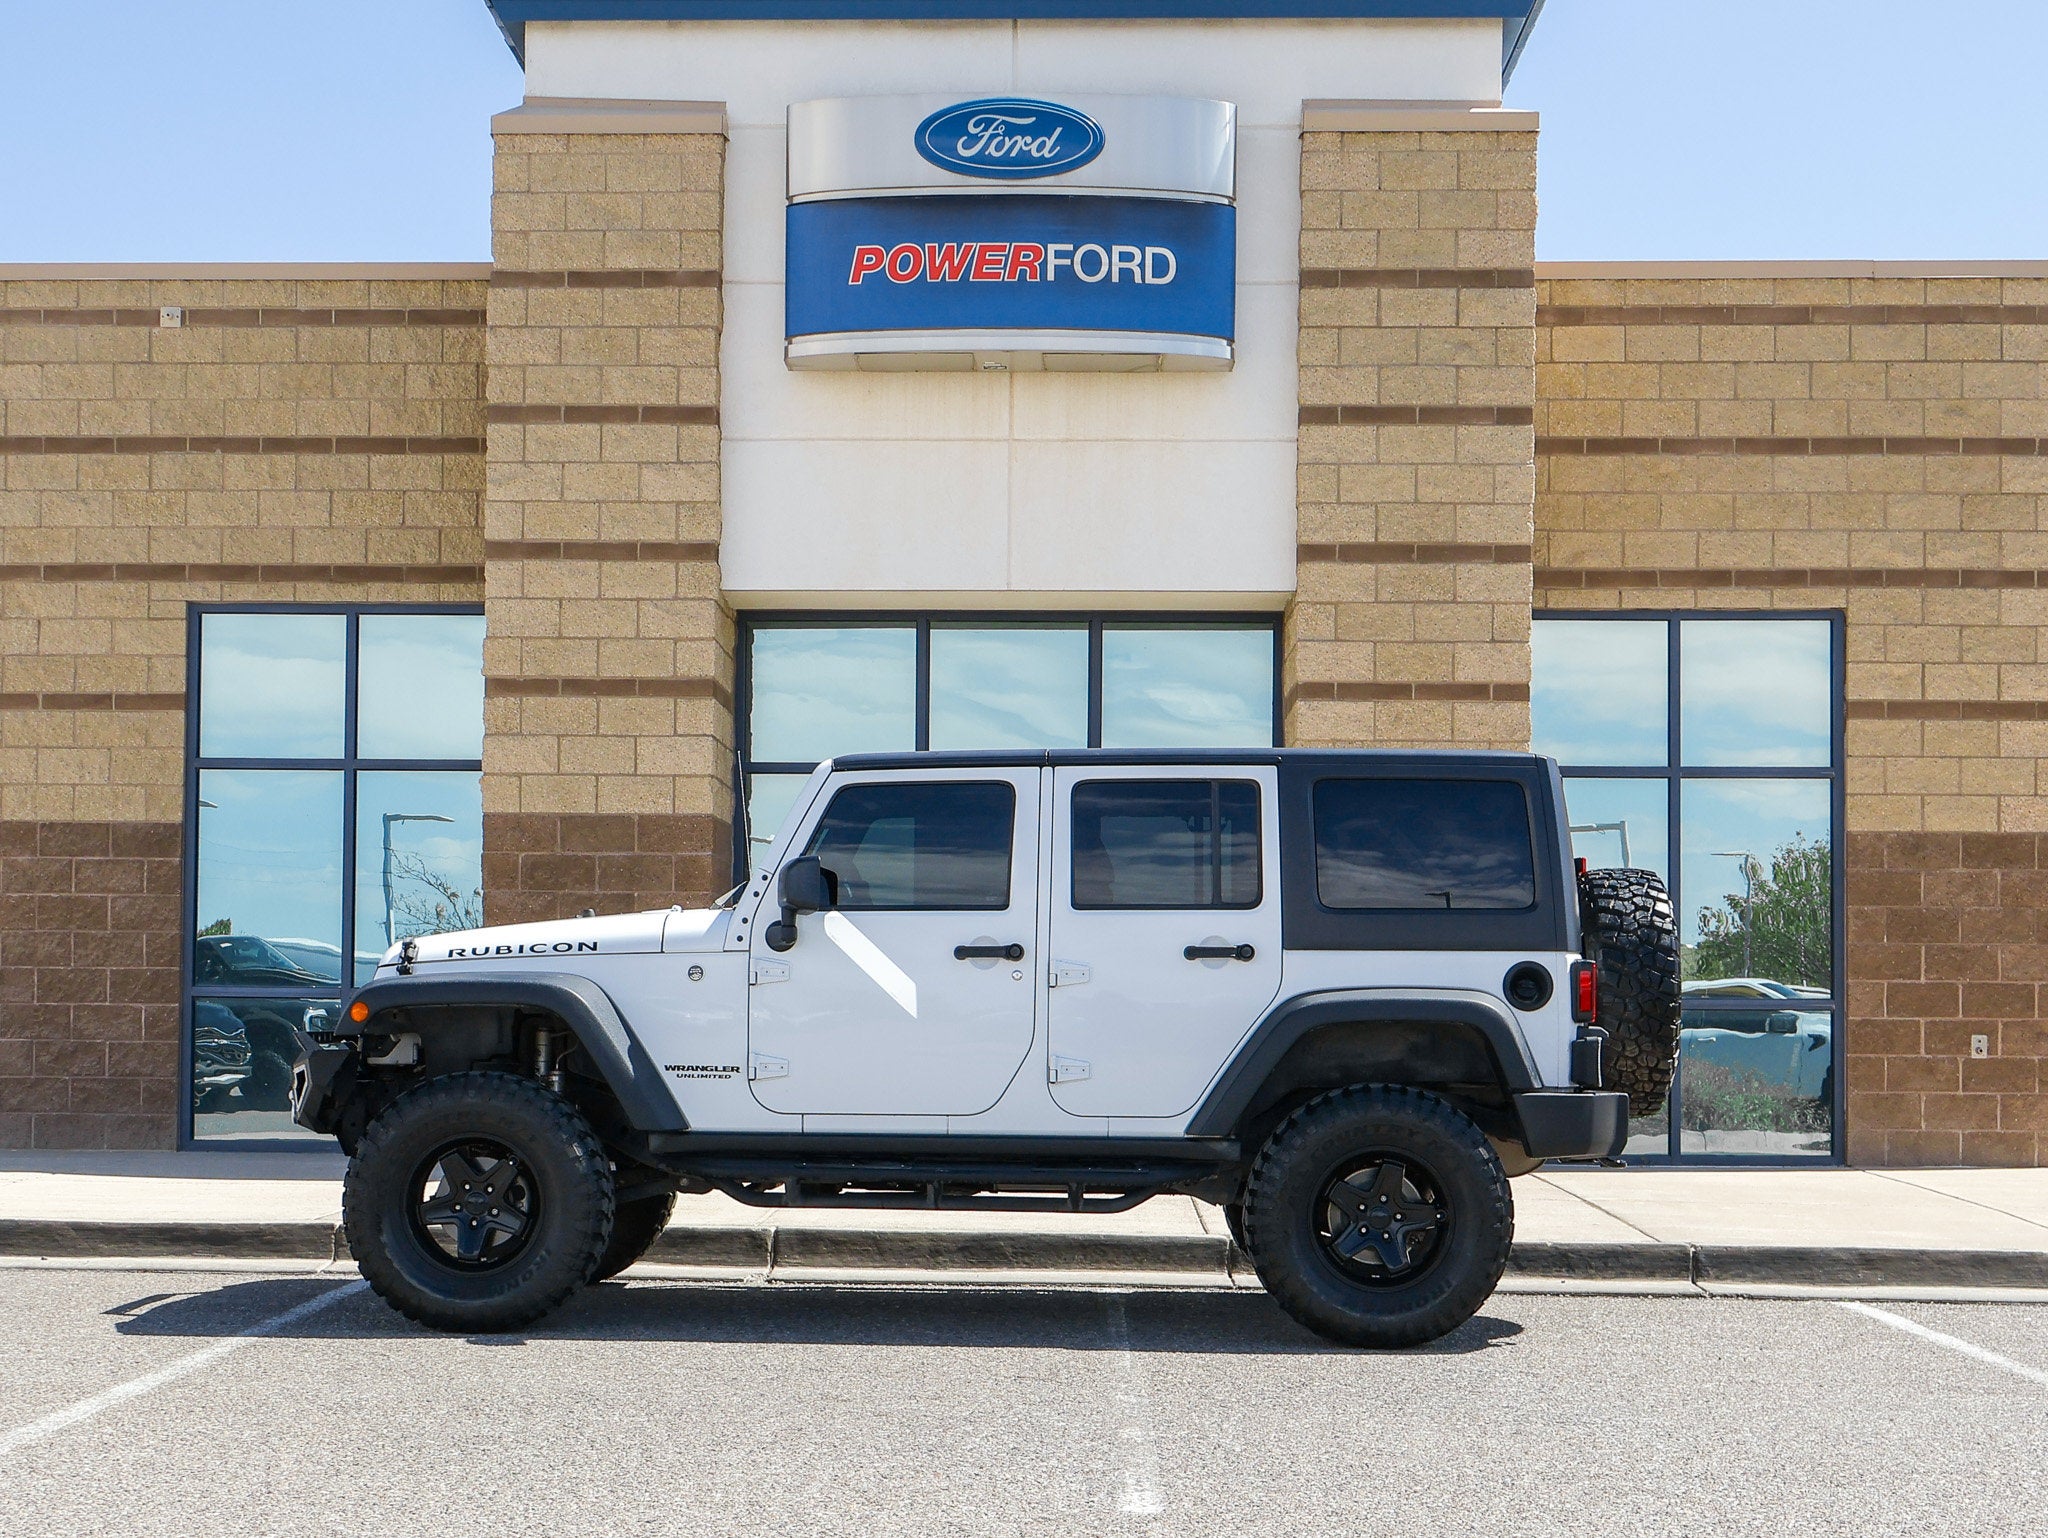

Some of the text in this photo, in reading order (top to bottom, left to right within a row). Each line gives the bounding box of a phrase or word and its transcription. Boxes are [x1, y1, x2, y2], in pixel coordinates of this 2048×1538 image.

[957, 114, 1063, 158] Ford
[447, 941, 598, 958] RUBICON
[664, 1064, 741, 1073] WRANGLER
